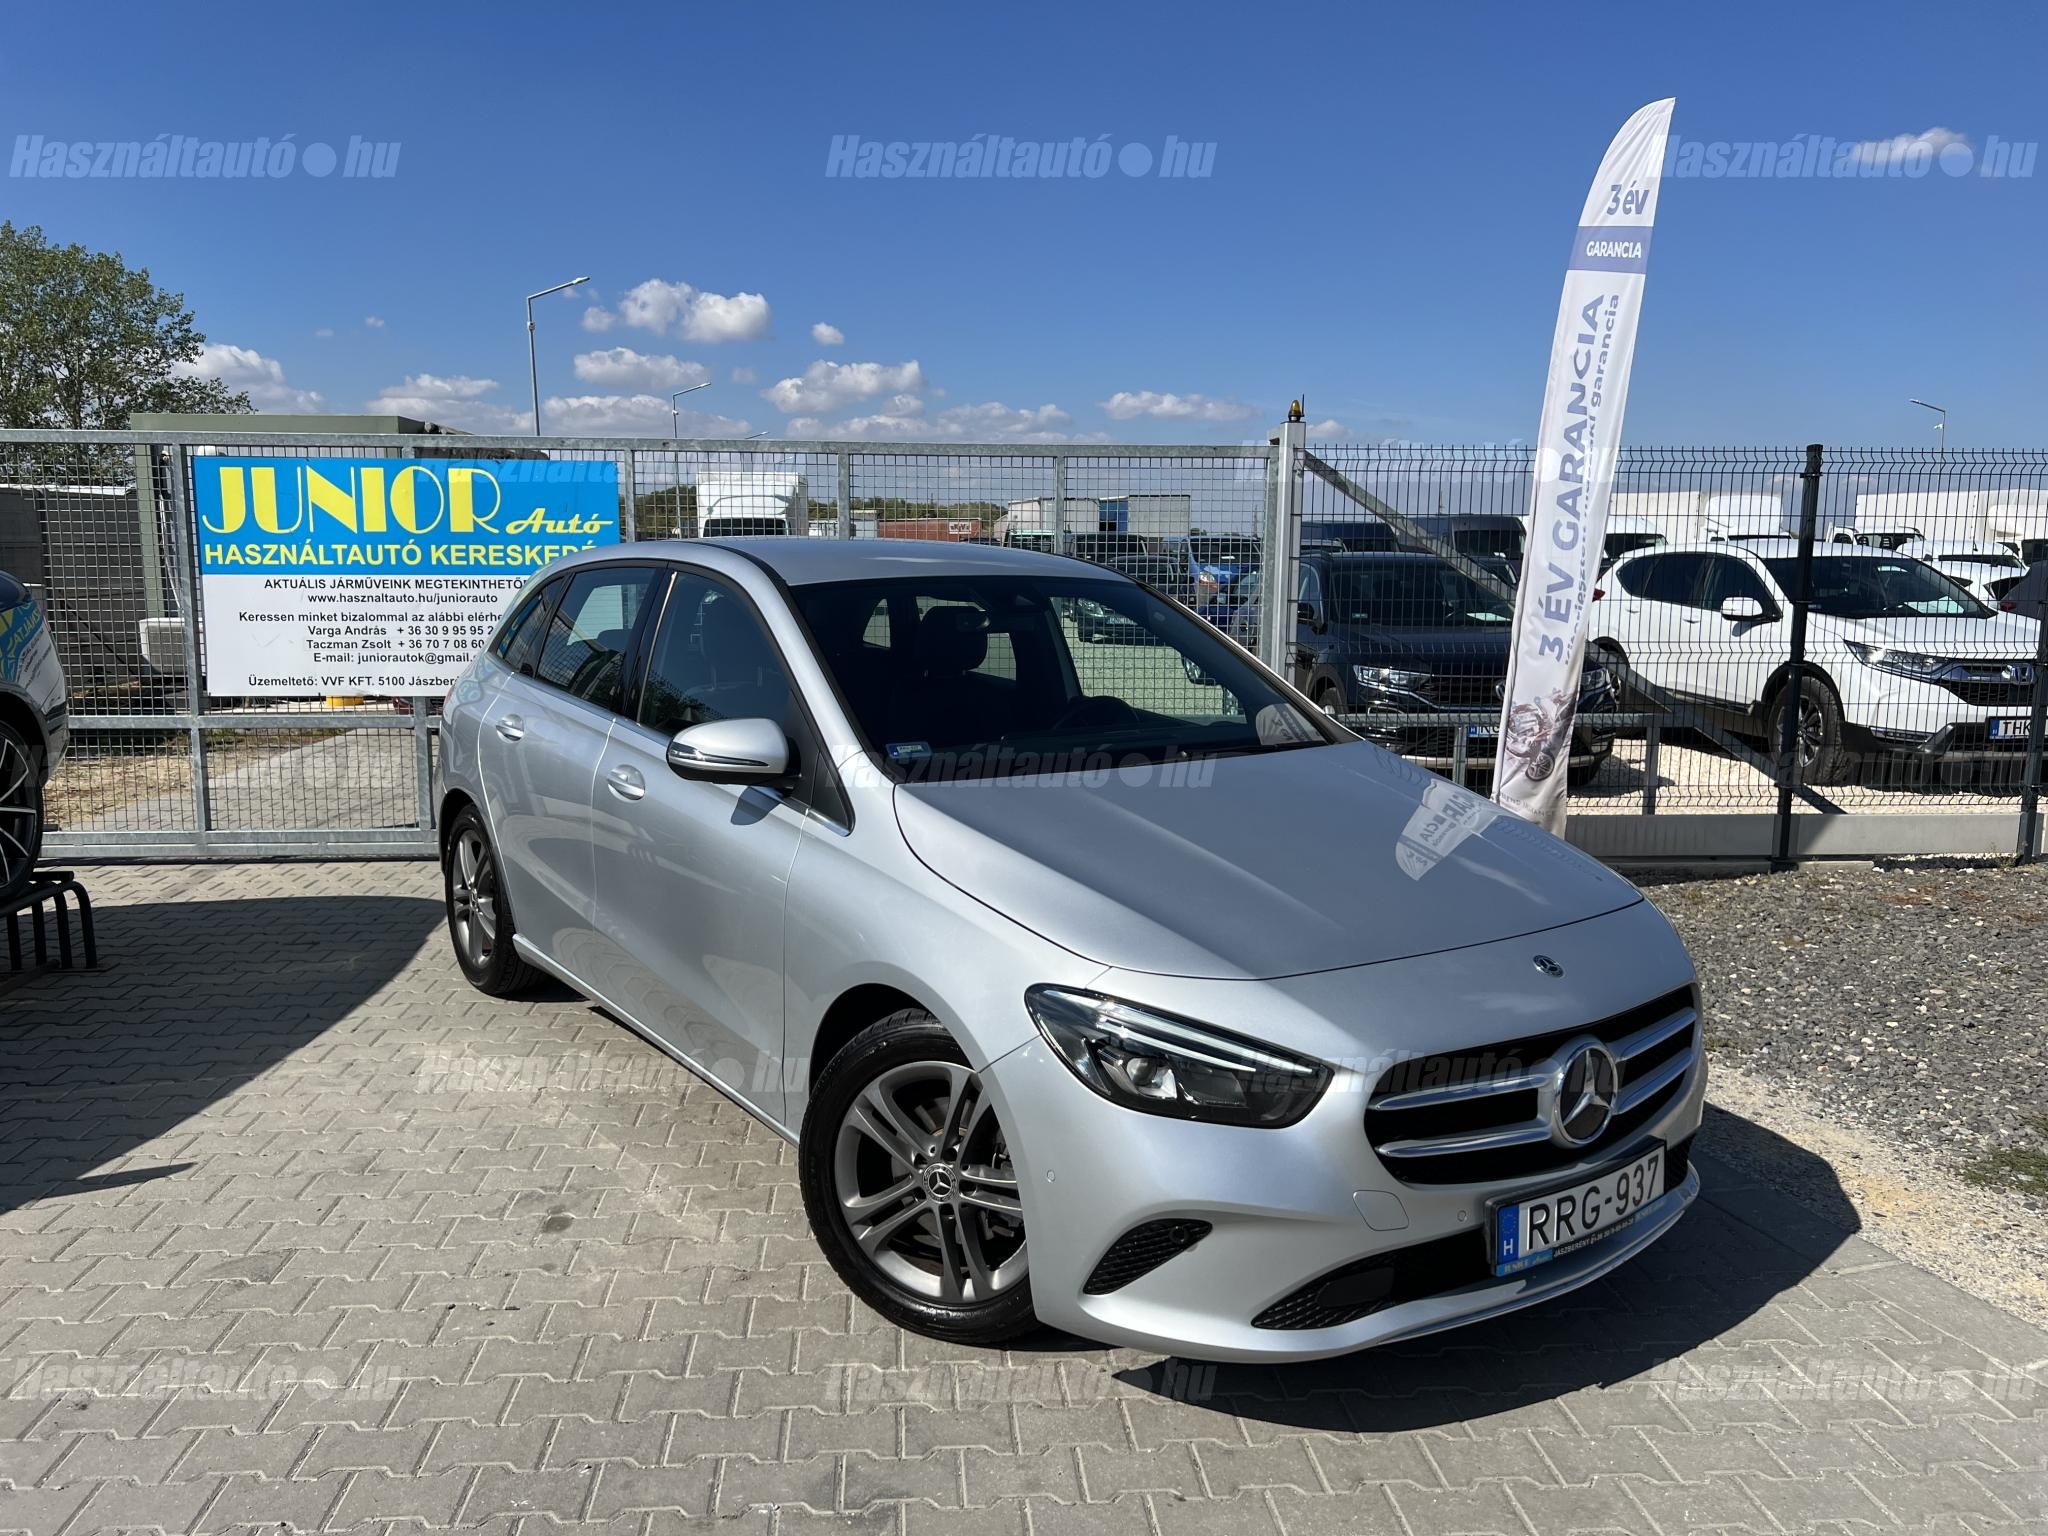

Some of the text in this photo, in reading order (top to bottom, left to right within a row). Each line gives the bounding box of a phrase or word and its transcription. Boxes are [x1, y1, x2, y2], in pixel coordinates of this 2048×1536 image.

[1606, 180, 1650, 215] 3 év
[1586, 240, 1642, 258] GARANCIA
[1591, 294, 1619, 407] garancia
[1552, 294, 1605, 551] GARANCIA
[202, 465, 613, 536] JUNIOR Autó
[204, 539, 422, 566] HASZNÁLTAUTÓ
[264, 576, 527, 590] AKTUÁLIS JÁRMŰVEINK MEGTEKINTHETŐ
[308, 593, 498, 604] www.hasznaltauto.hu/juniorauto
[1538, 562, 1575, 624] ÉV
[239, 612, 294, 622] Keressen
[298, 612, 339, 622] minket
[341, 612, 408, 622] bizalommal
[412, 614, 425, 622] az
[428, 611, 464, 622] alábbi
[308, 626, 342, 637] Varga
[344, 625, 387, 635] András
[408, 626, 421, 635] 36
[425, 626, 439, 635] 30
[442, 626, 449, 635] 9
[452, 626, 467, 635] 95
[470, 626, 484, 635] 95
[306, 639, 358, 649] Taczman
[361, 639, 391, 649] Zsolt
[409, 639, 422, 649] 36
[426, 639, 440, 649] 70
[443, 639, 450, 649] 7
[453, 639, 467, 649] 08
[1538, 633, 1565, 663] 3
[313, 653, 476, 664] E-mail: juniorautok@gmail.
[248, 675, 318, 686] Üzemeltető:
[321, 676, 345, 686] VVF
[348, 676, 375, 686] KFT.
[378, 676, 405, 686] 5100
[1527, 1154, 1659, 1251] RRG-937
[1503, 1238, 1513, 1256] H
